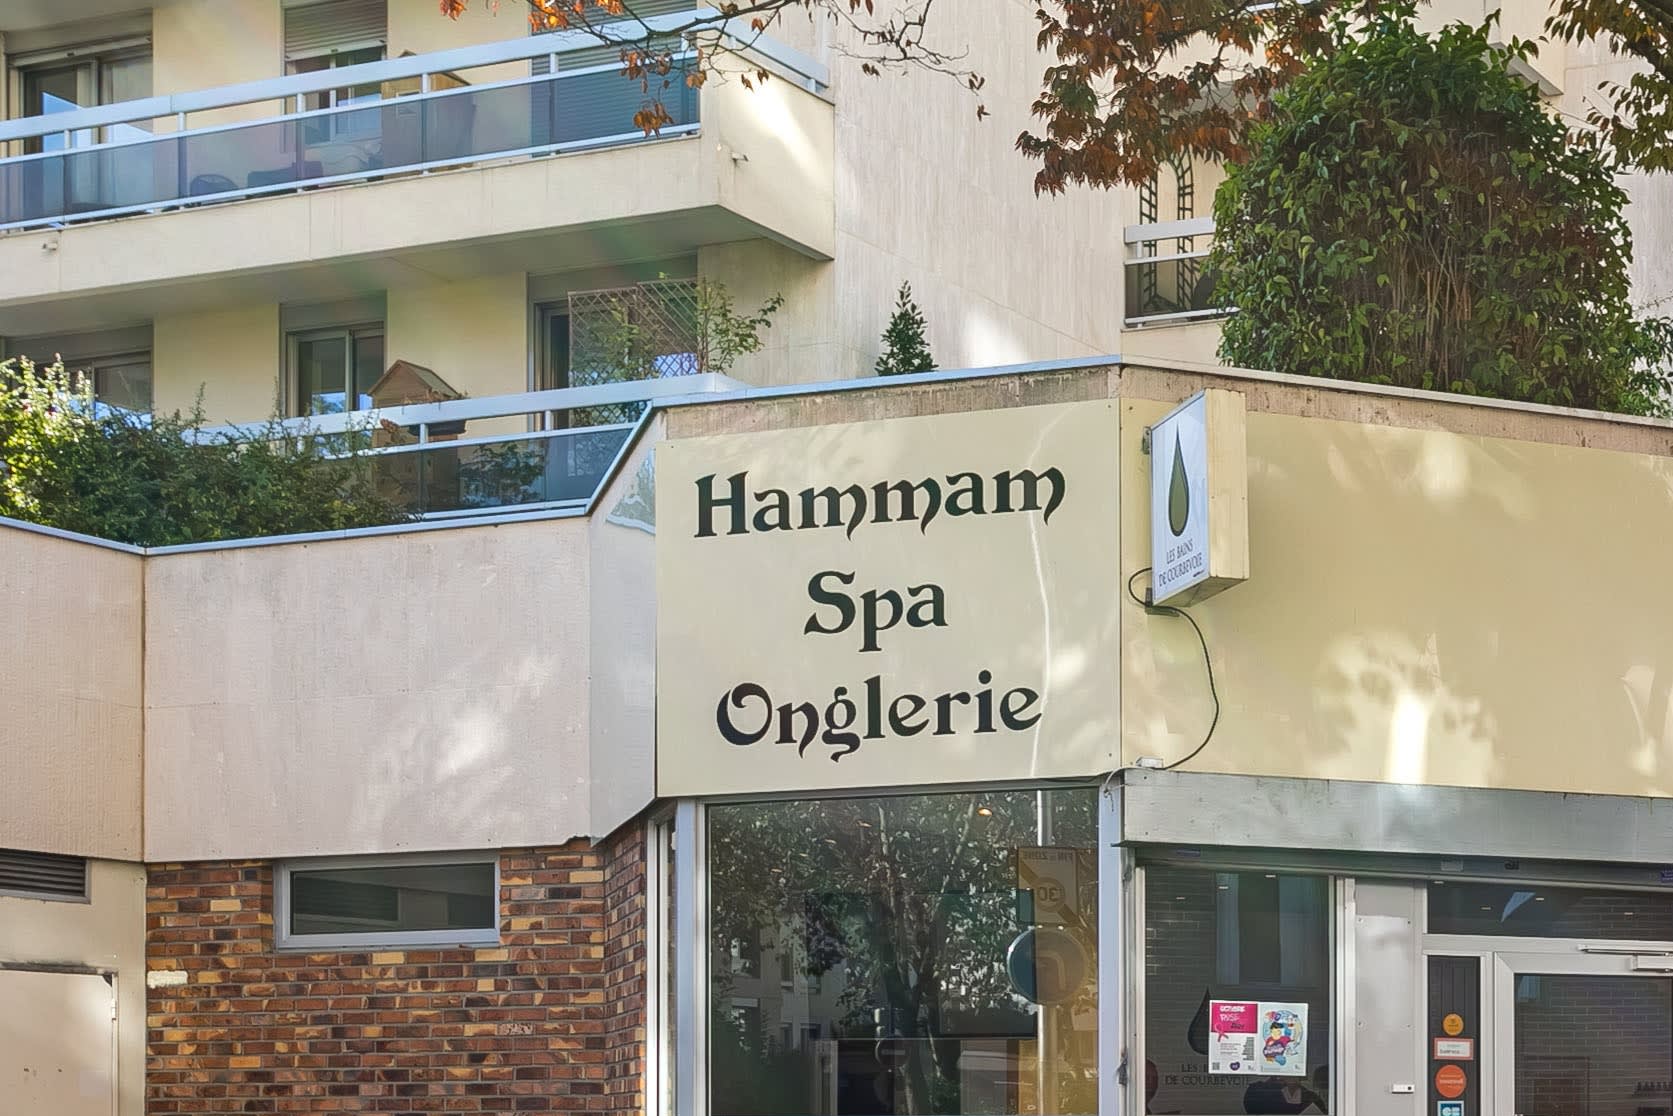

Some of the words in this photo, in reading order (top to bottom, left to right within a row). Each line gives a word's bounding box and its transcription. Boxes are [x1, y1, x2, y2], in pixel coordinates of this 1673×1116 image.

[694, 466, 1066, 541] Hammam
[803, 569, 949, 653] Spa
[716, 669, 1043, 764] Onglerie
